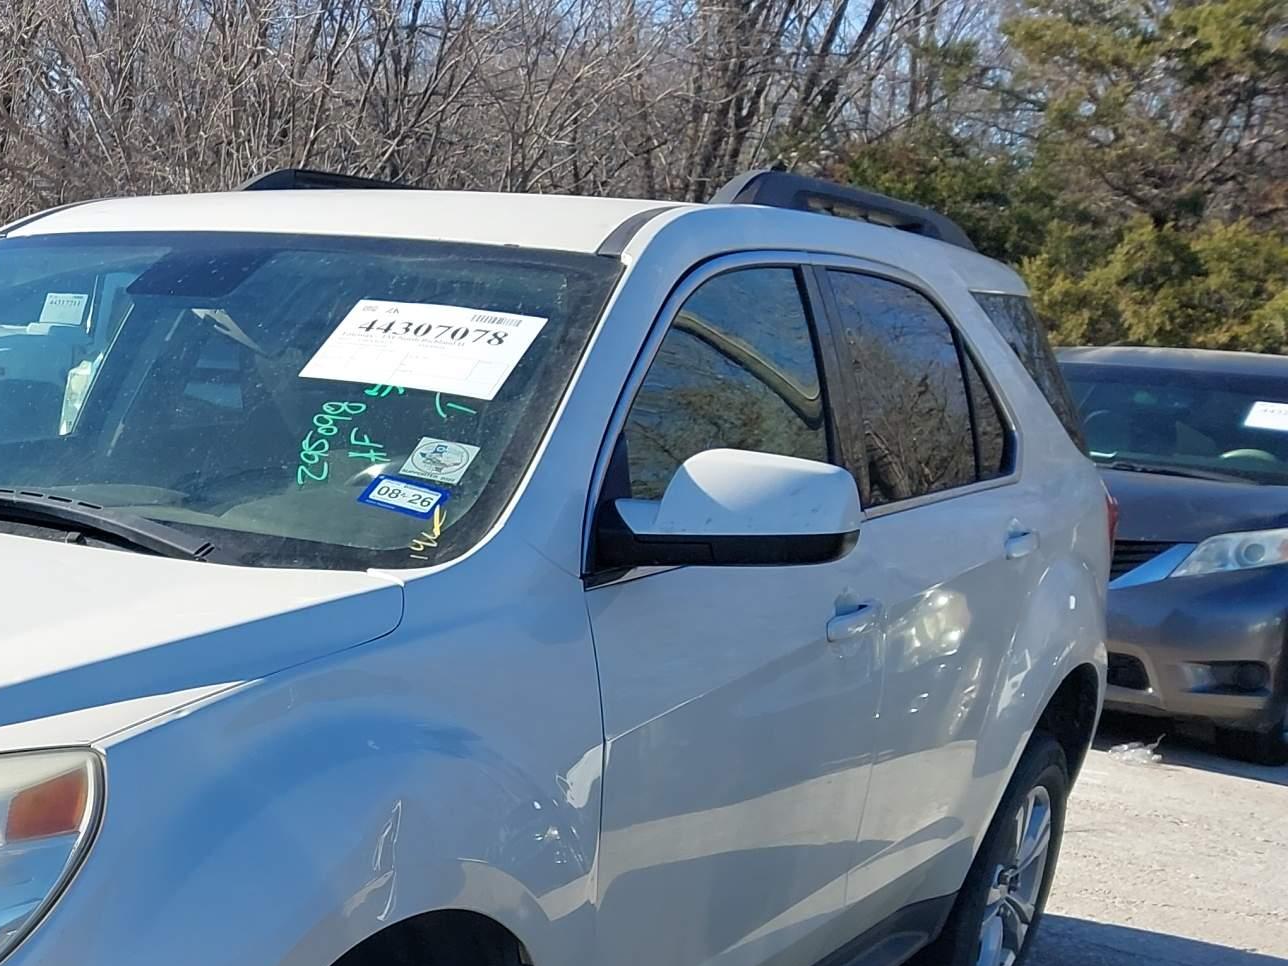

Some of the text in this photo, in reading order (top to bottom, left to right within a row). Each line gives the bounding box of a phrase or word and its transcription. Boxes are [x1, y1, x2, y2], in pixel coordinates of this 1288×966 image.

[357, 318, 509, 347] 44307078
[377, 485, 402, 499] 08
[407, 493, 434, 508] 26
